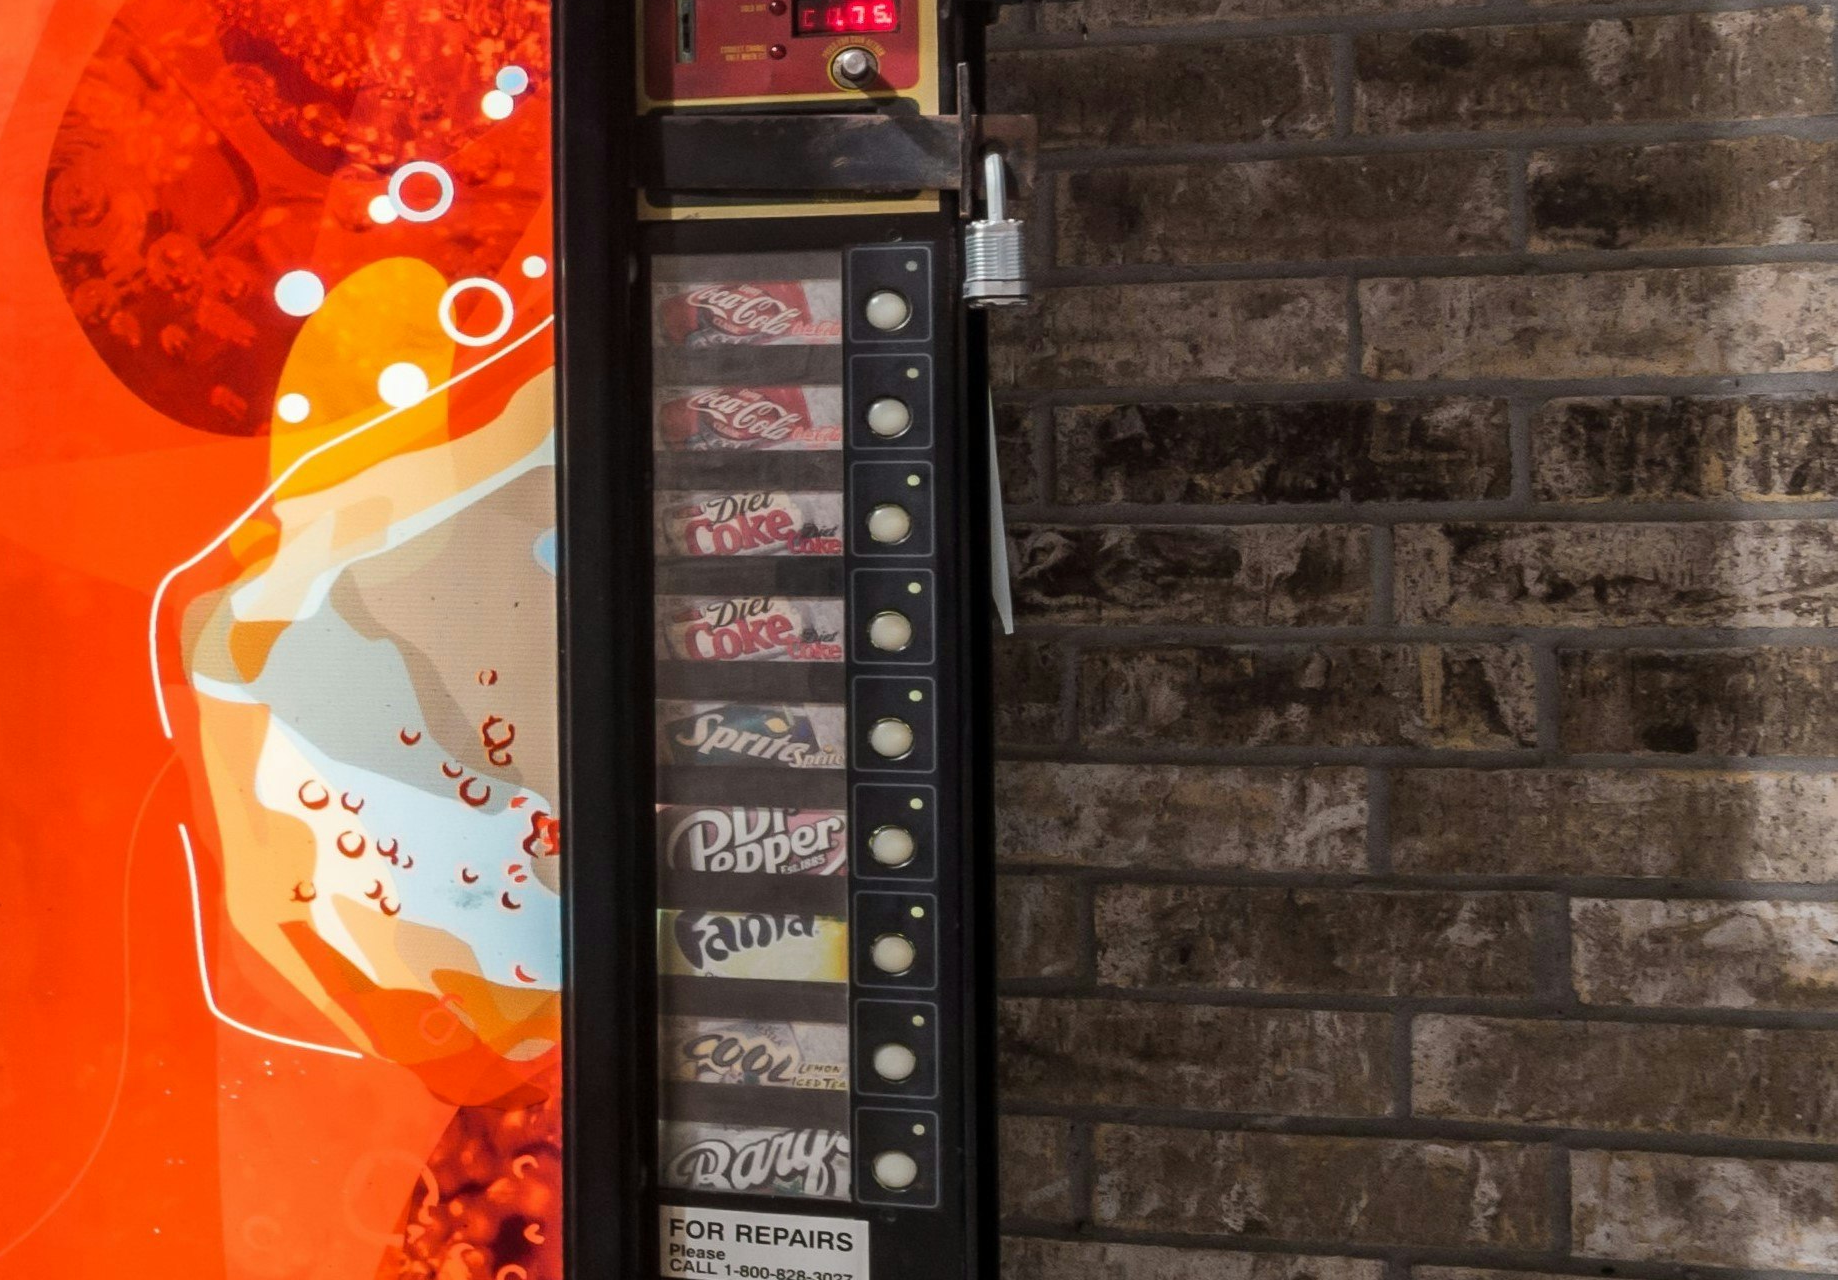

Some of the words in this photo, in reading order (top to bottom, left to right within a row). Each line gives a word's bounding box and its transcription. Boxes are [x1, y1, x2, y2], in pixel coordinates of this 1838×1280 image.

[686, 284, 802, 335] Coca-Cola
[686, 387, 802, 440] Coca-Cola
[706, 492, 773, 524] Diet
[685, 509, 794, 555] Coke
[787, 531, 843, 554] Coke
[706, 597, 773, 629] Diet
[685, 615, 794, 659] Coke
[787, 634, 843, 659] Coke
[676, 713, 811, 762] Sprite
[789, 748, 844, 768] Sprite
[668, 809, 845, 874] Pepper
[732, 806, 786, 846] Dr
[683, 1034, 793, 1083] COOL
[798, 1063, 841, 1074] LEMON
[792, 1077, 821, 1087] ICED
[669, 1218, 725, 1241] FOR
[735, 1223, 854, 1252] REPAIRS
[669, 1243, 726, 1261] Please
[669, 1258, 718, 1275] CALL
